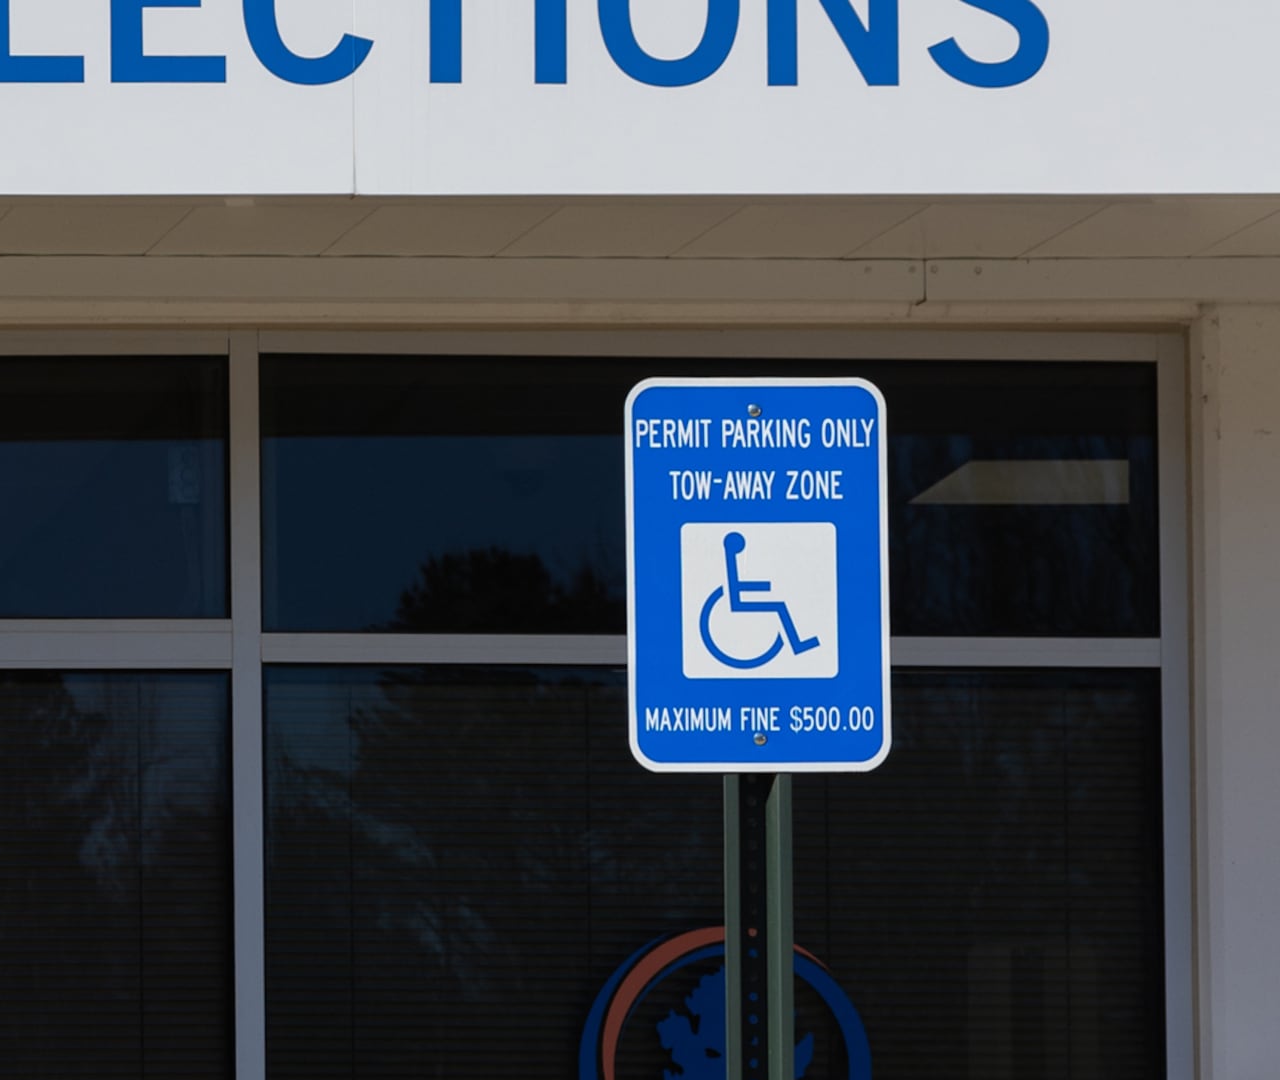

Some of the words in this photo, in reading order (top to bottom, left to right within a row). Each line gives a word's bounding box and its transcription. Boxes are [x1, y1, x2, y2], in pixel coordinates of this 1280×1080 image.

[636, 419, 712, 448] PERMIT
[721, 418, 811, 449] PARKING
[821, 418, 875, 448] ONLY
[669, 470, 775, 500] TOW-AWAY
[786, 470, 844, 500] ZONE
[645, 707, 732, 731] MAXIMUM
[740, 707, 781, 731] FINE
[789, 705, 874, 732] $500.00
